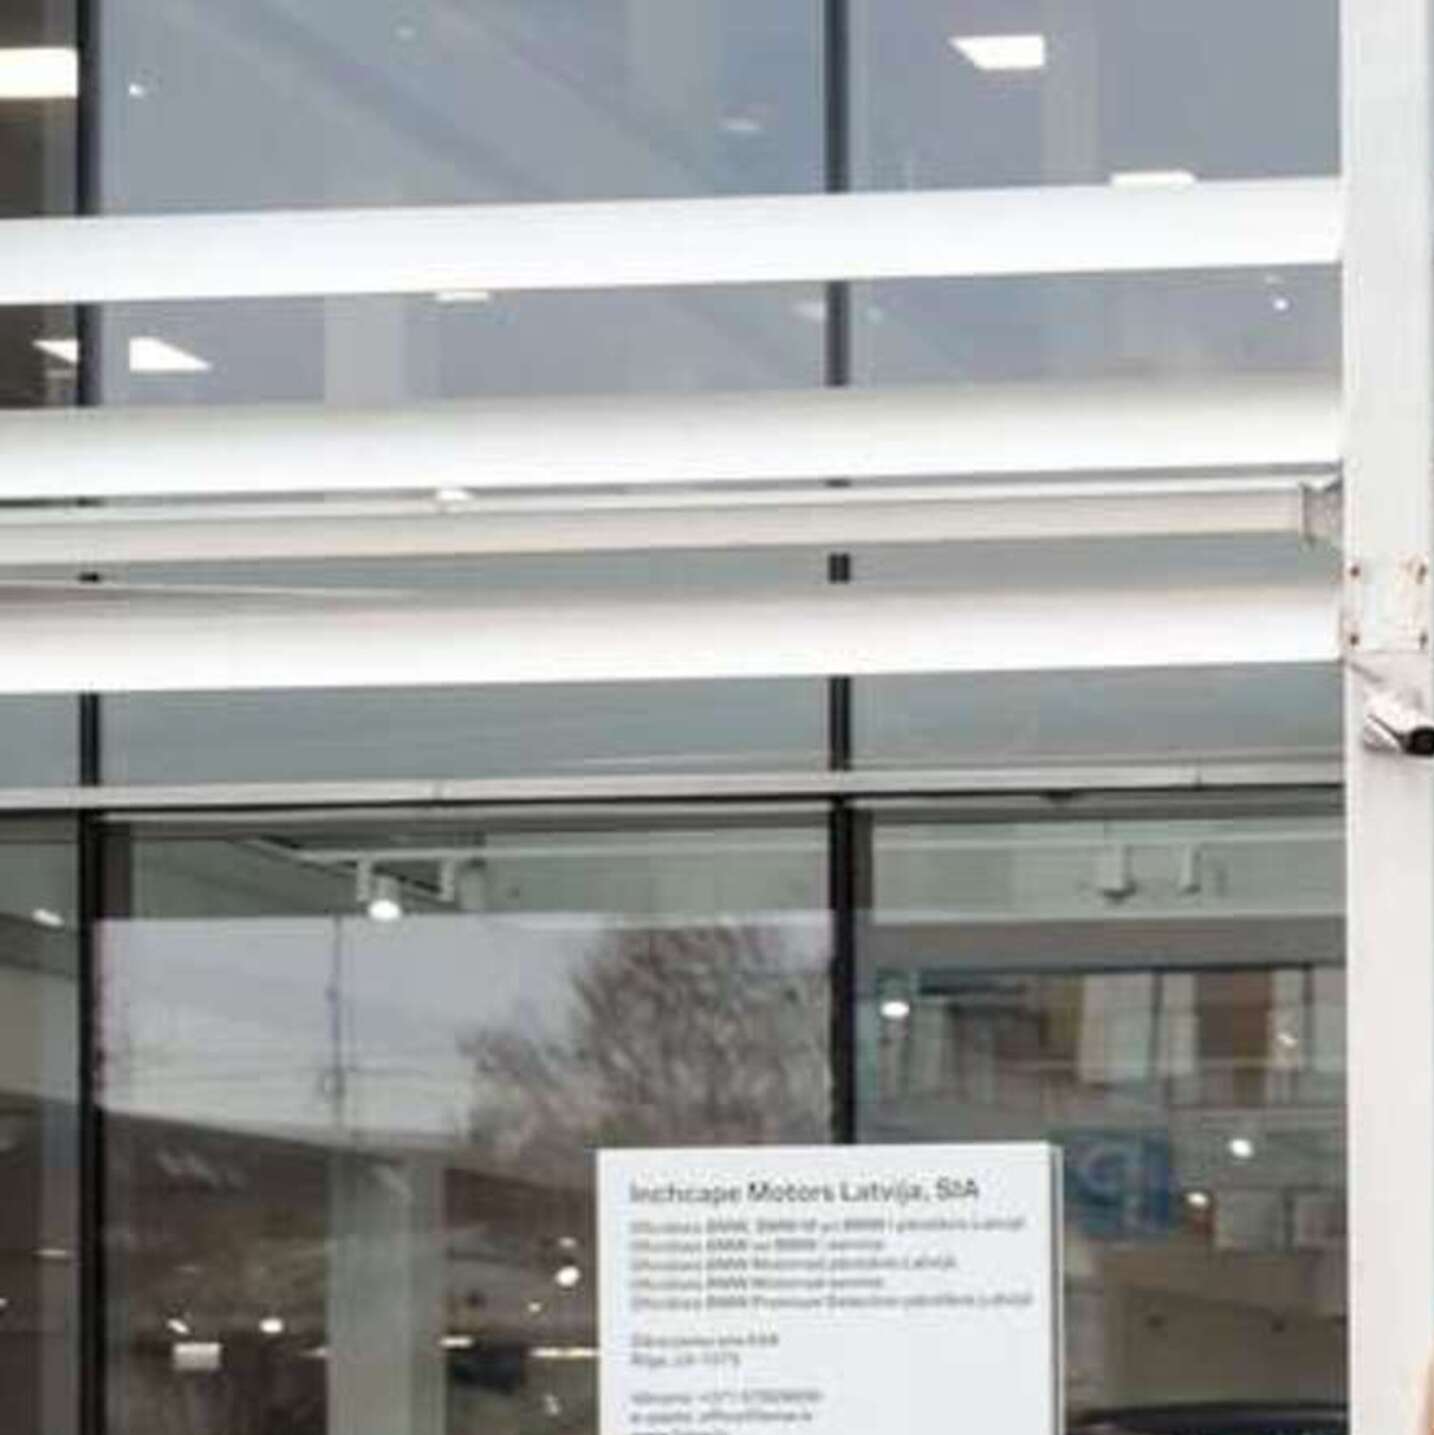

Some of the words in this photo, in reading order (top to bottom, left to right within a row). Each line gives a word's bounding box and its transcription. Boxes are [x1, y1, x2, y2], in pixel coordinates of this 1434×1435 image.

[630, 1181, 742, 1206] Inchcape
[748, 1181, 834, 1202] Motors
[936, 1176, 980, 1200] SIA
